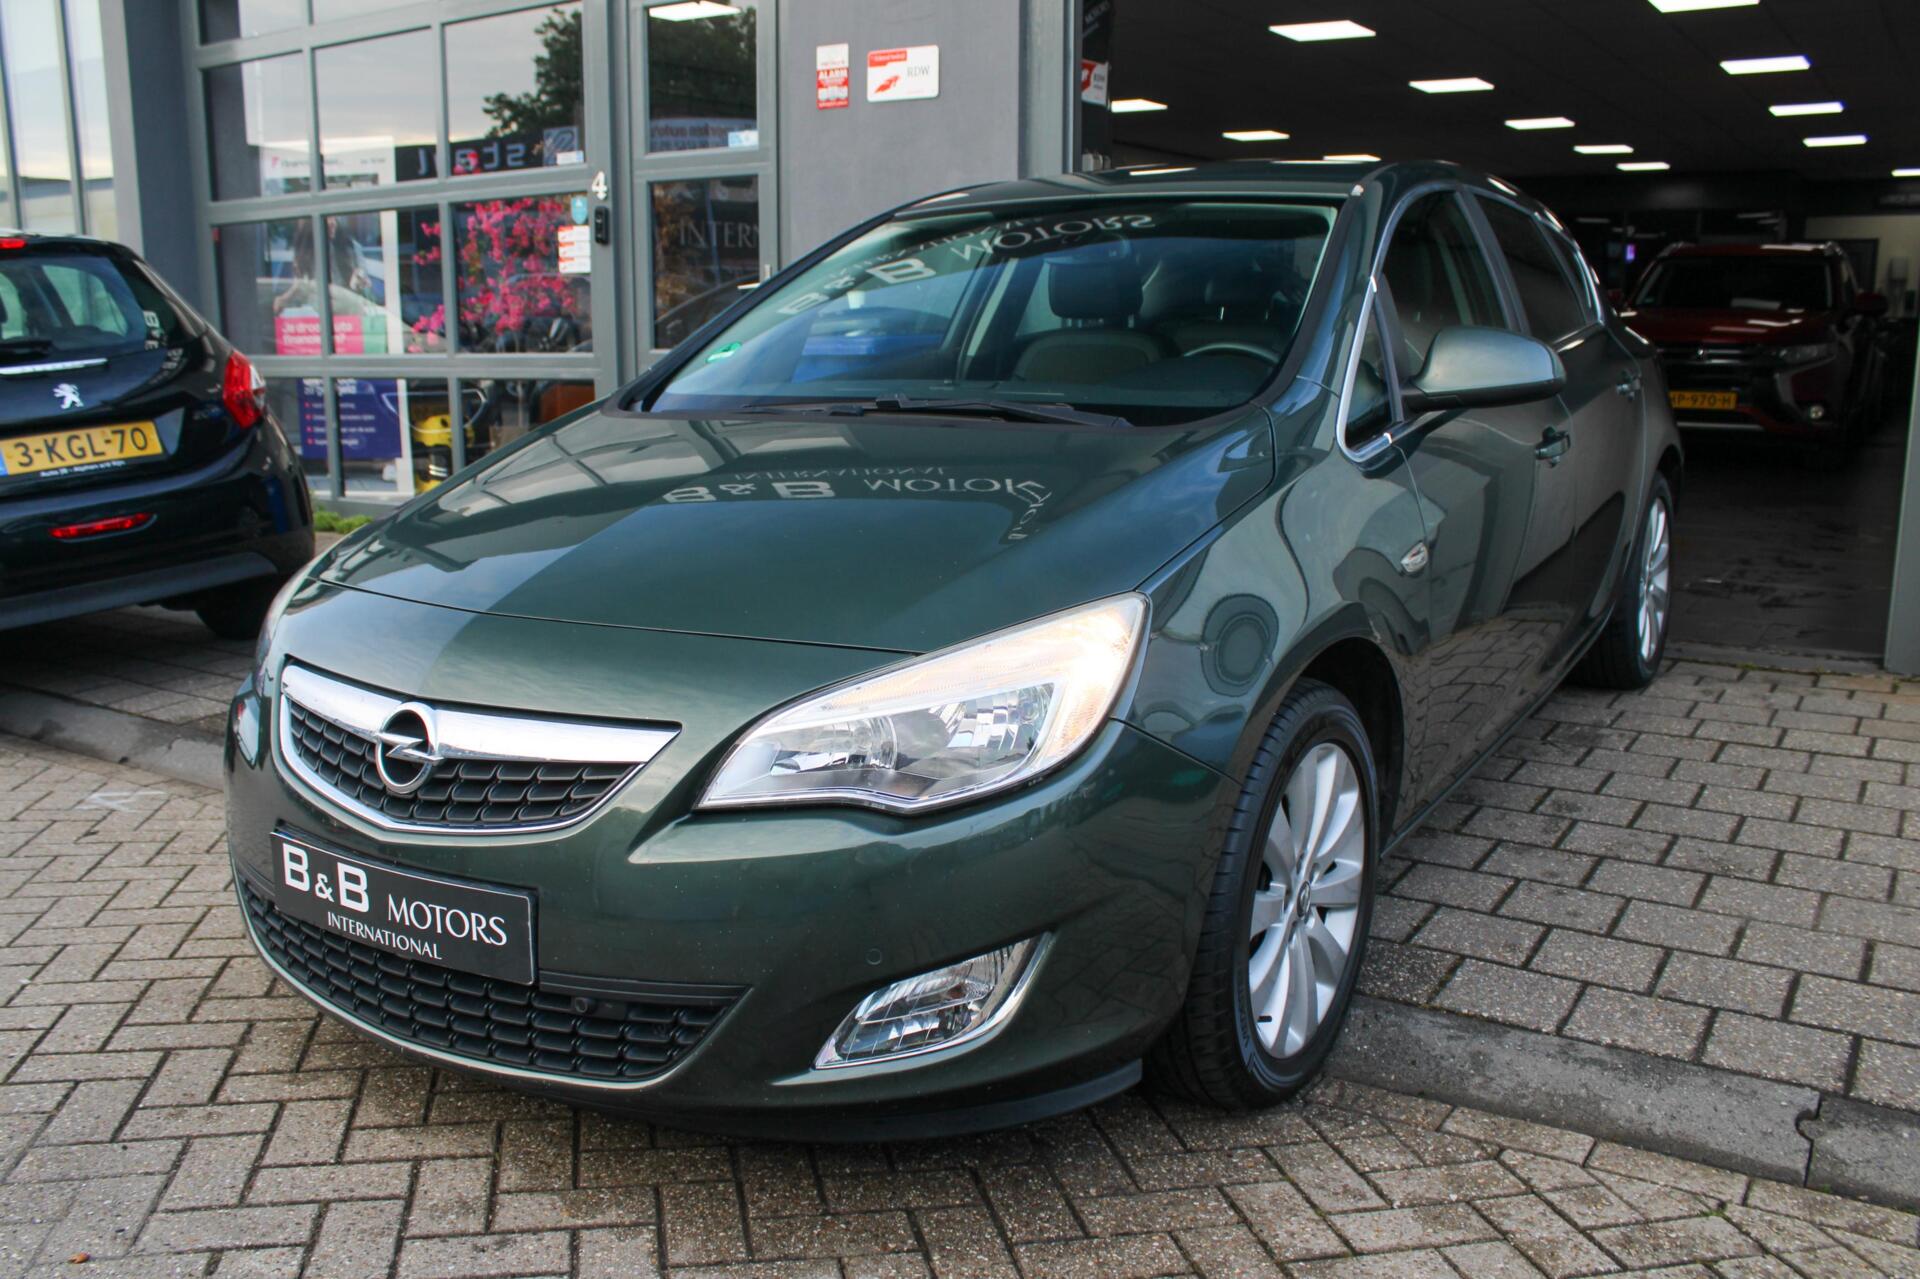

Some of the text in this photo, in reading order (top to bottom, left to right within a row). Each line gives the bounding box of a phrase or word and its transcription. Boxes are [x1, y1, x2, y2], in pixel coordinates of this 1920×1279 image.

[906, 65, 931, 78] RDW
[591, 170, 608, 200] 4
[14, 427, 148, 467] 3-KGL-70
[327, 911, 442, 960] INTERNATIONAL
[388, 893, 508, 946] MOTORS
